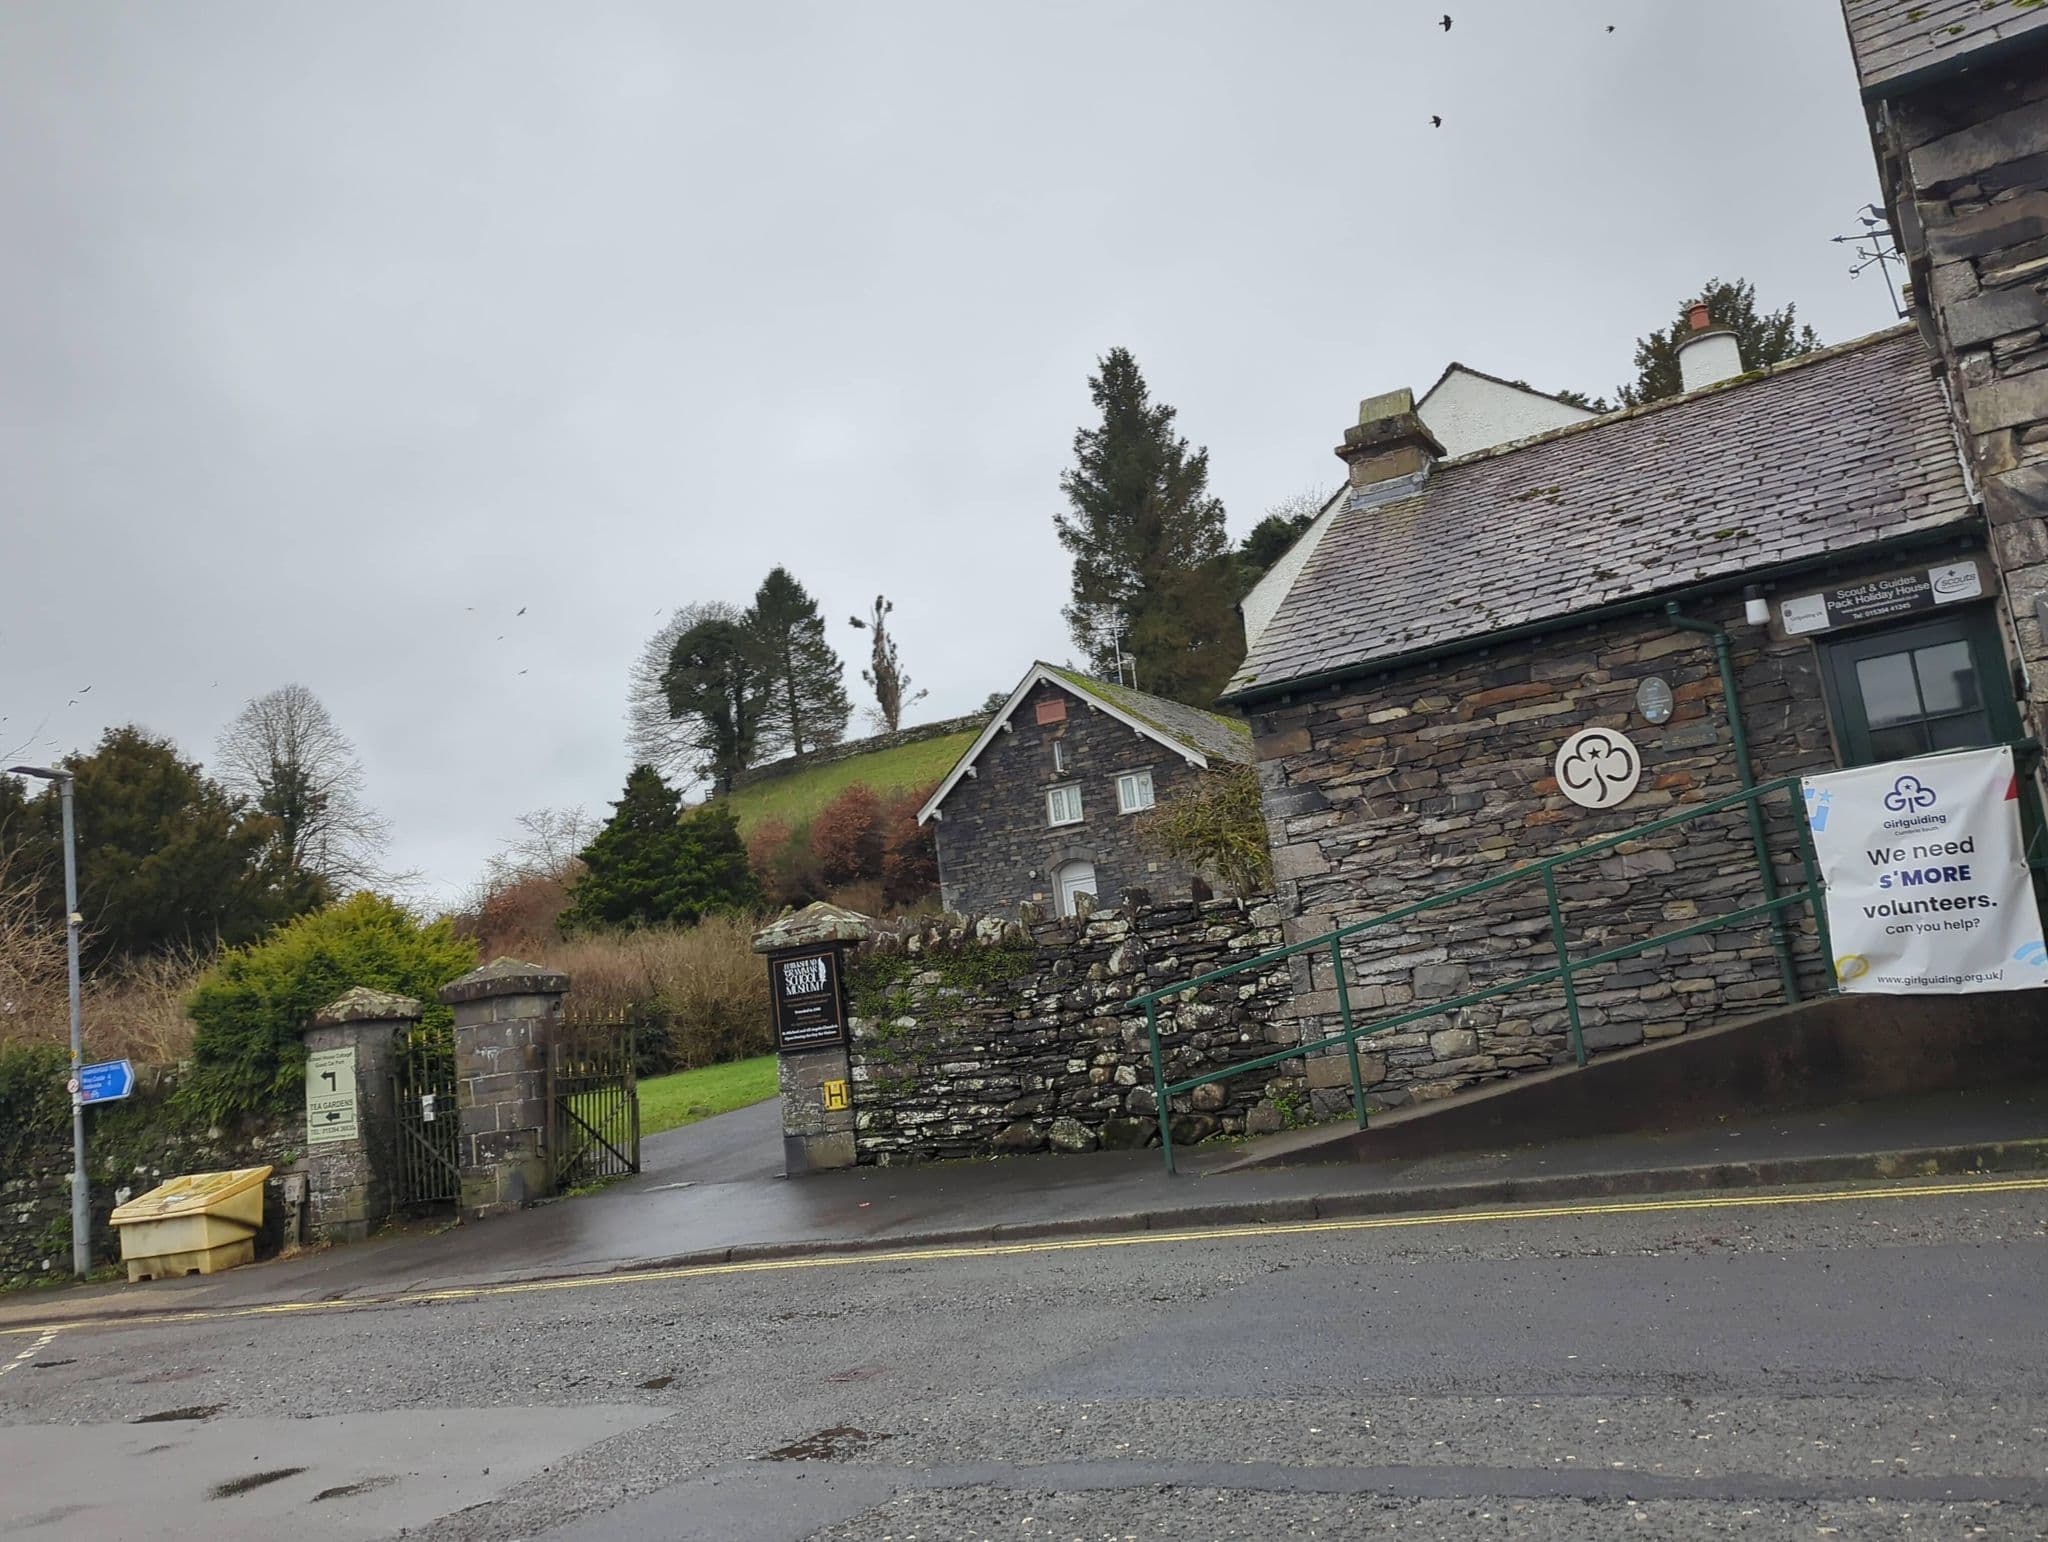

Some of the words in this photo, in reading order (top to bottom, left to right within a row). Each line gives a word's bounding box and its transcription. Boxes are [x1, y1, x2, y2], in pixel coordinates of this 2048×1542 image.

[1827, 598, 1854, 610] Pack
[1855, 590, 1894, 604] Holiday
[1896, 582, 1930, 595] House
[1836, 586, 1867, 599] Scout
[1868, 583, 1877, 592] &
[1879, 576, 1917, 590] Guides
[1883, 814, 1947, 829] Girlguiding
[1867, 847, 1906, 867] We
[1912, 836, 1975, 859] need
[1862, 894, 1998, 919] volunteers.
[1885, 923, 1914, 935] Can
[1916, 923, 1941, 935] you
[1944, 918, 1981, 931] help?
[785, 973, 816, 986] SCHOOL
[1877, 969, 2004, 986] www.girlguiding.org.uk/
[786, 982, 820, 996] MUSEUM
[828, 1083, 844, 1107] H
[310, 1103, 322, 1111] TEA
[323, 1098, 353, 1110] GARDENS
